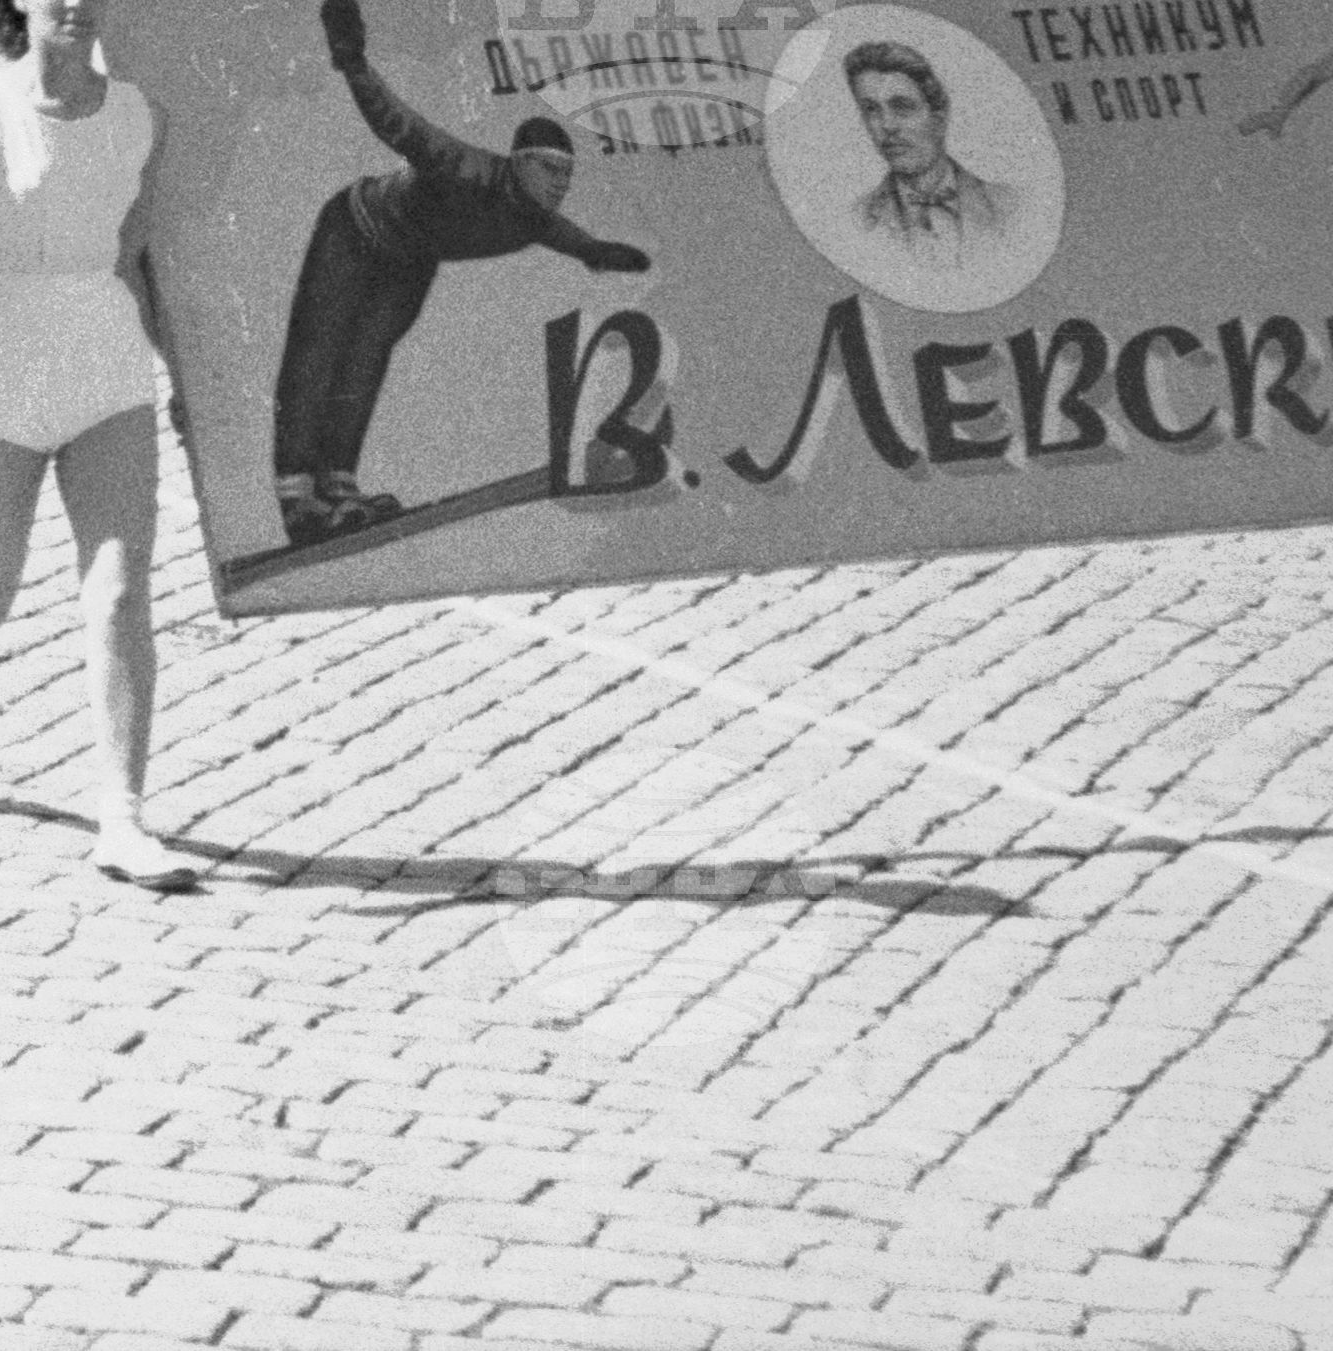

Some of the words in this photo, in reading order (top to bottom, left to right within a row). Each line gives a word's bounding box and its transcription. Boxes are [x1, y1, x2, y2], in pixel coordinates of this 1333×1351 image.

[1051, 81, 1078, 125] И
[1091, 72, 1207, 122] СПОРТ
[544, 308, 701, 498] В.
[724, 293, 1332, 485] ЛЕВСК
